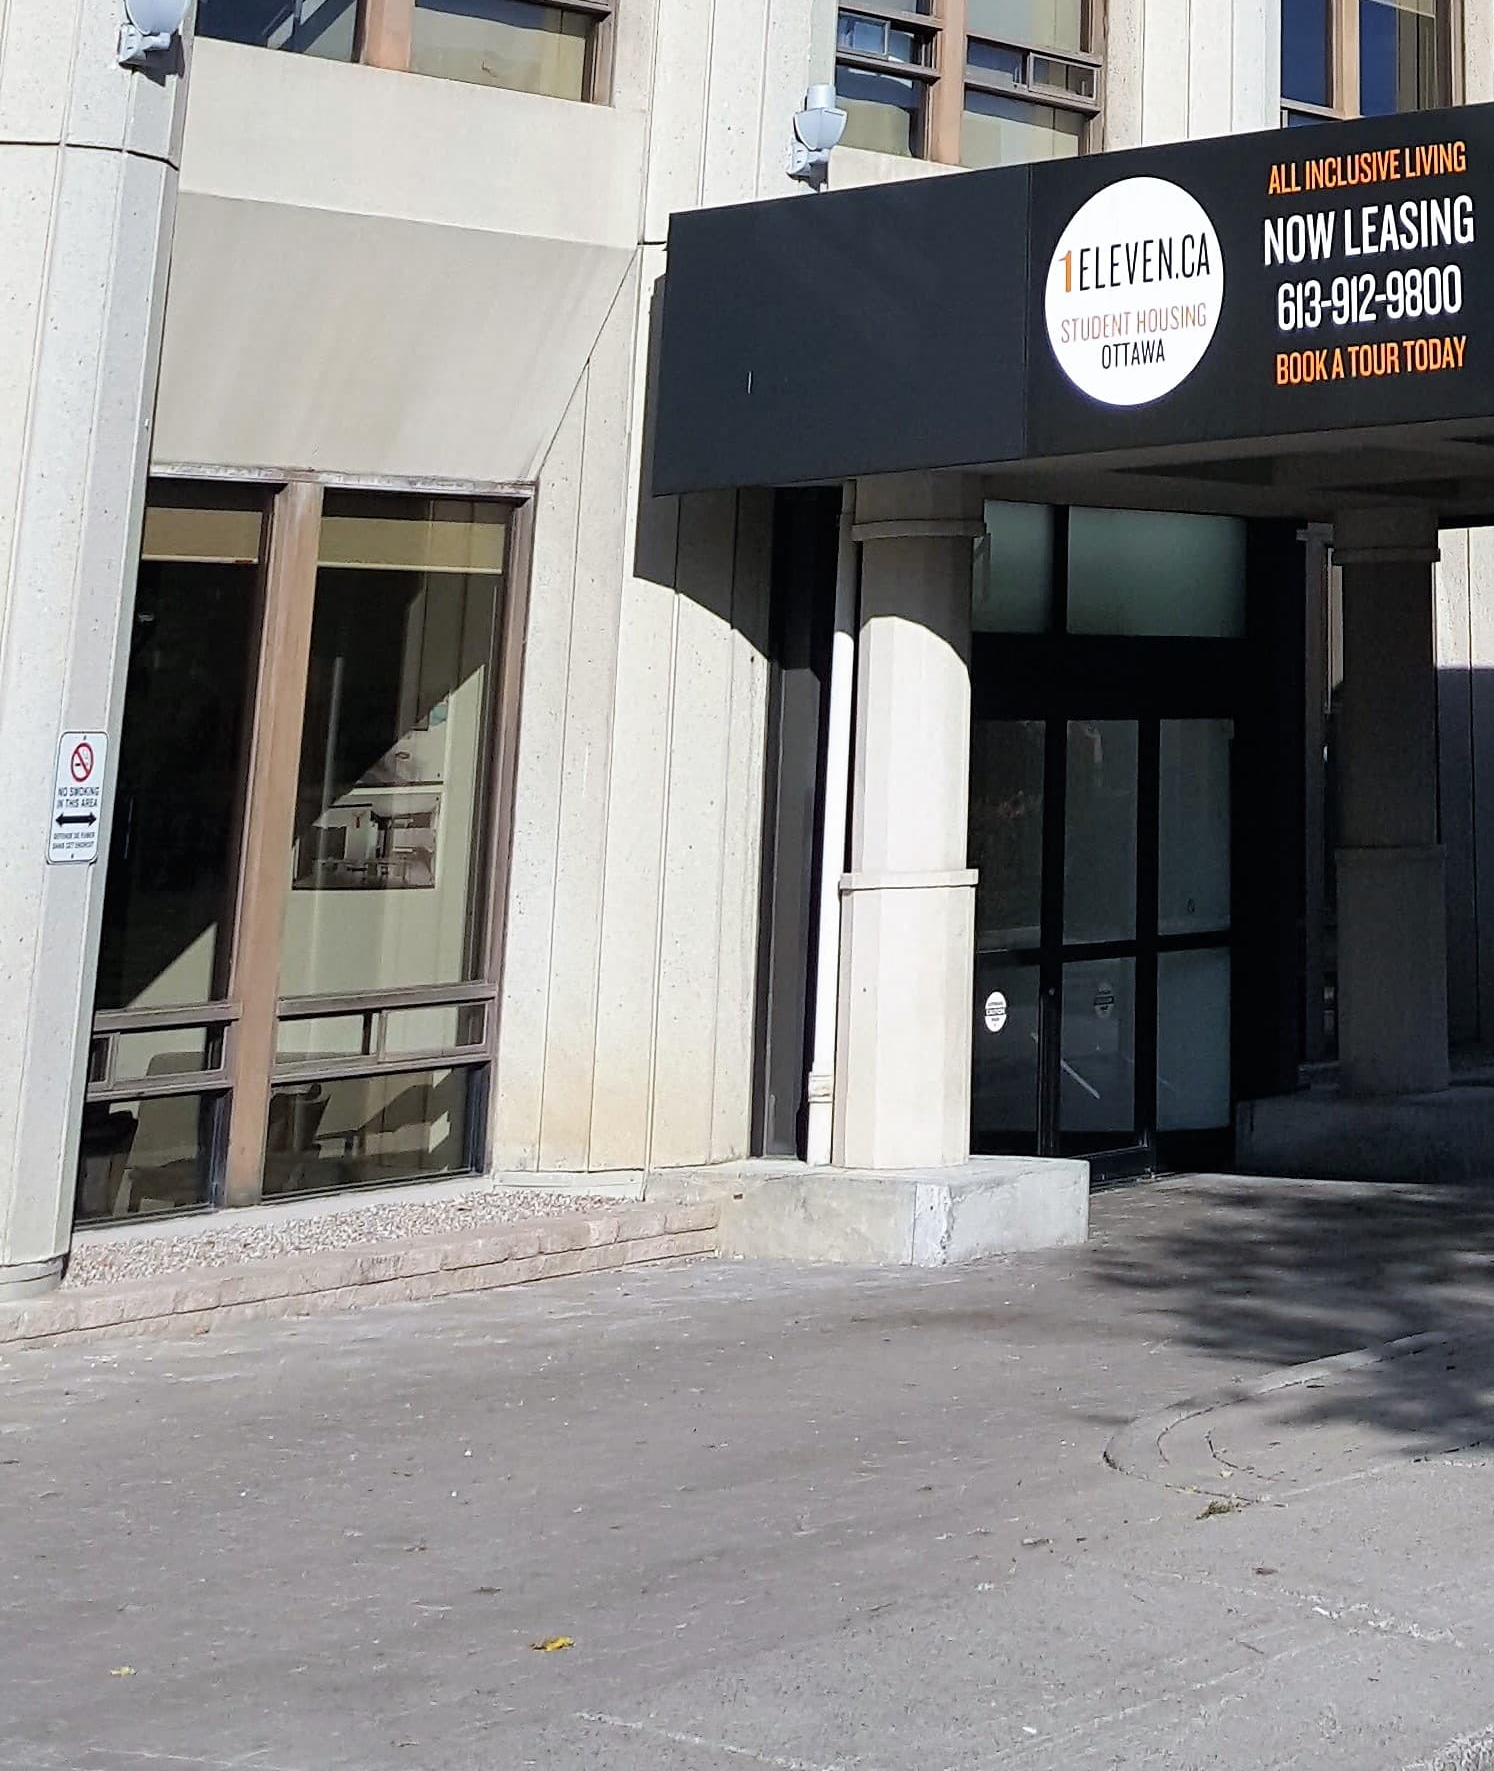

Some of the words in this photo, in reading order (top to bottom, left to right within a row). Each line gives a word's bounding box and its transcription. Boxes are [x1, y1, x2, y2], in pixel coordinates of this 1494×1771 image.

[1268, 163, 1301, 194] ALL
[1305, 149, 1400, 190] INCLUSIVE
[1405, 141, 1466, 178] LIVING
[1264, 210, 1335, 266] NOW
[1344, 195, 1474, 256] LEASING
[1058, 232, 1210, 292] 1ELEVEN.CA
[1061, 311, 1131, 343] STUDENT
[1137, 302, 1206, 335] HOUSING
[1278, 264, 1462, 331] 613-912-9800
[1102, 338, 1165, 369] OTTAWA
[1276, 349, 1328, 385] BOOK
[1331, 347, 1345, 379] A
[1348, 342, 1400, 377] TOUR
[1403, 335, 1466, 373] TODAY
